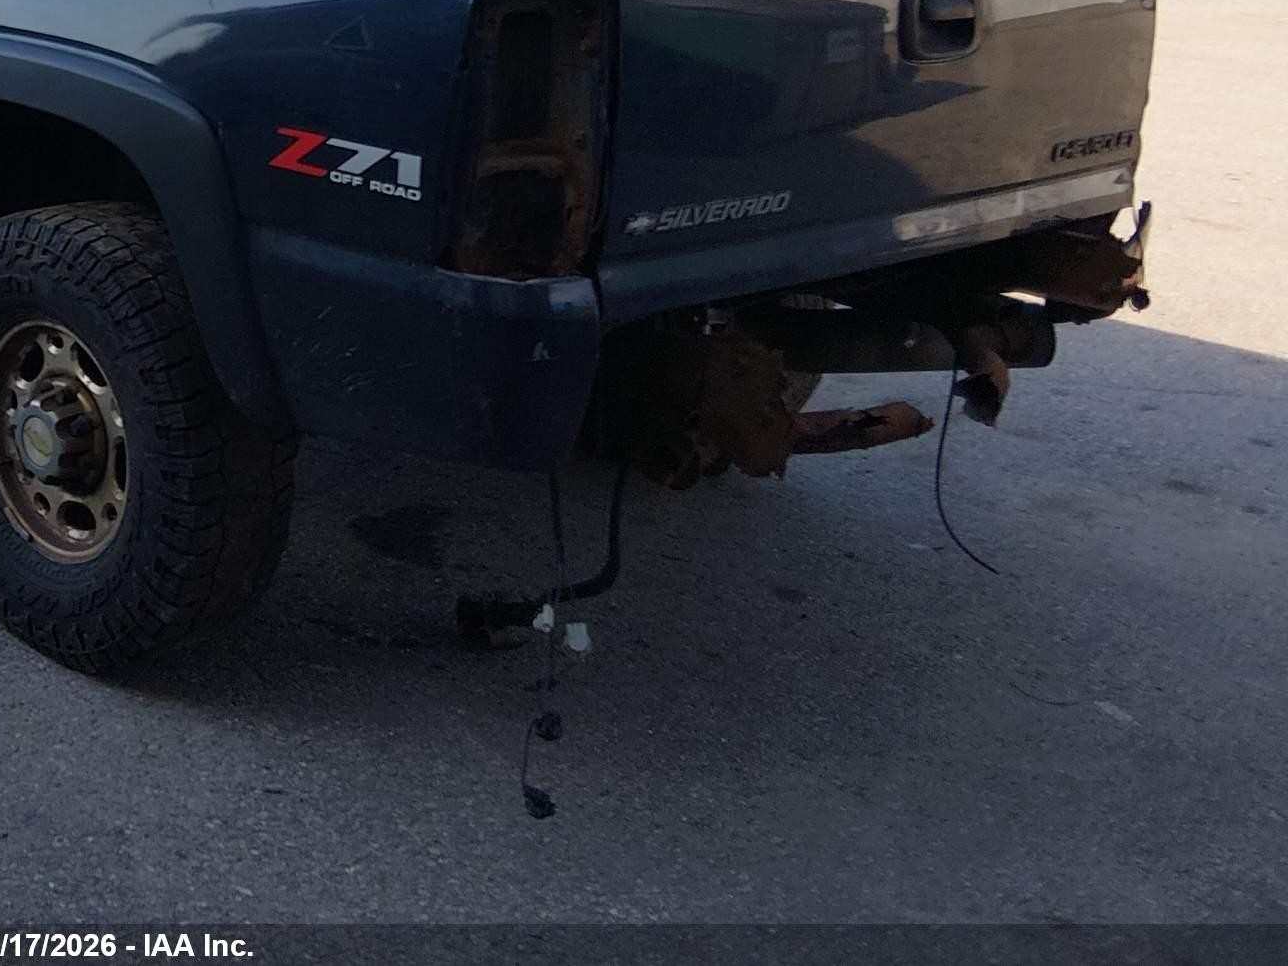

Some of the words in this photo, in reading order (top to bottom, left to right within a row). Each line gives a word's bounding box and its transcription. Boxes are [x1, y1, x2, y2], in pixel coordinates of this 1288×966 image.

[268, 126, 423, 188] Z71
[329, 170, 363, 187] OFF
[369, 180, 422, 202] ROAD
[656, 190, 792, 231] SILVERADO
